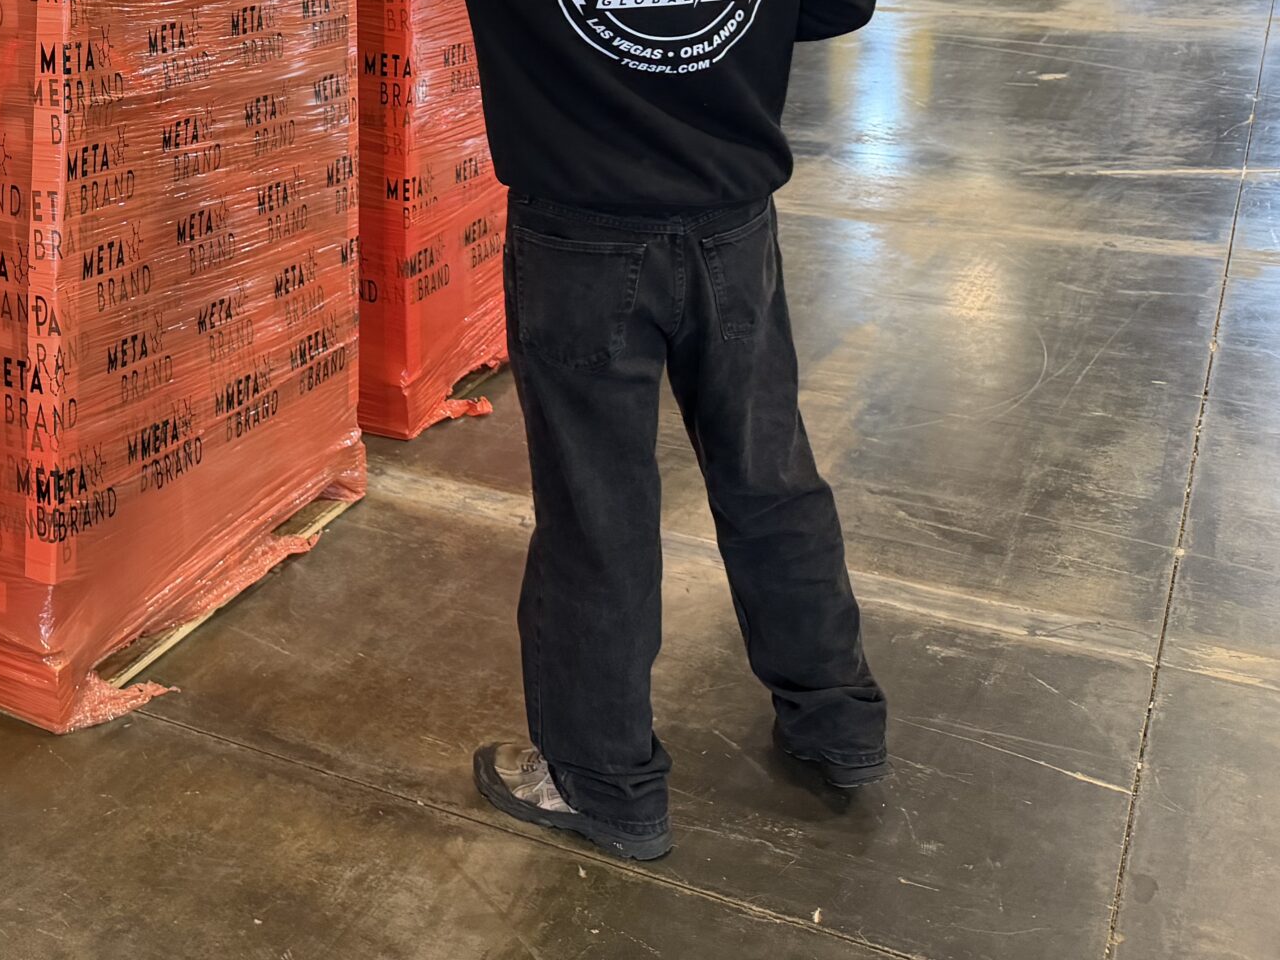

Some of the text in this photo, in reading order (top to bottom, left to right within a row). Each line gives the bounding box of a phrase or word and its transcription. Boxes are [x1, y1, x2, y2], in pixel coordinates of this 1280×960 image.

[231, 5, 263, 37] META
[586, 9, 744, 59] LAS VEGAS ORLANDO
[40, 40, 95, 75] META
[148, 22, 185, 57] META
[444, 44, 467, 67] META
[365, 54, 411, 77] META
[620, 58, 710, 73] TCB3PL.COM
[63, 73, 124, 114] BRAND
[314, 74, 342, 103] META
[245, 94, 276, 128] META
[163, 117, 199, 152] META
[254, 120, 295, 157] BRAND
[68, 143, 109, 182] META
[174, 144, 220, 182] BRAND
[326, 155, 353, 187] META
[455, 158, 478, 183] META
[81, 170, 135, 215] BRAND
[258, 181, 289, 216] META
[386, 177, 424, 203] META
[177, 209, 213, 245] META
[268, 204, 308, 243] BRAND
[465, 219, 487, 246] META
[83, 240, 125, 280] META
[189, 233, 235, 275] BRAND
[409, 248, 435, 276] META
[471, 233, 501, 268] BRAND
[98, 265, 151, 310] BRAND
[275, 263, 305, 299] META
[417, 264, 450, 300] BRAND
[198, 297, 232, 335] META
[107, 334, 148, 374] META
[208, 319, 254, 362] BRAND
[122, 355, 173, 404] BRAND
[5, 394, 77, 430] BRAND
